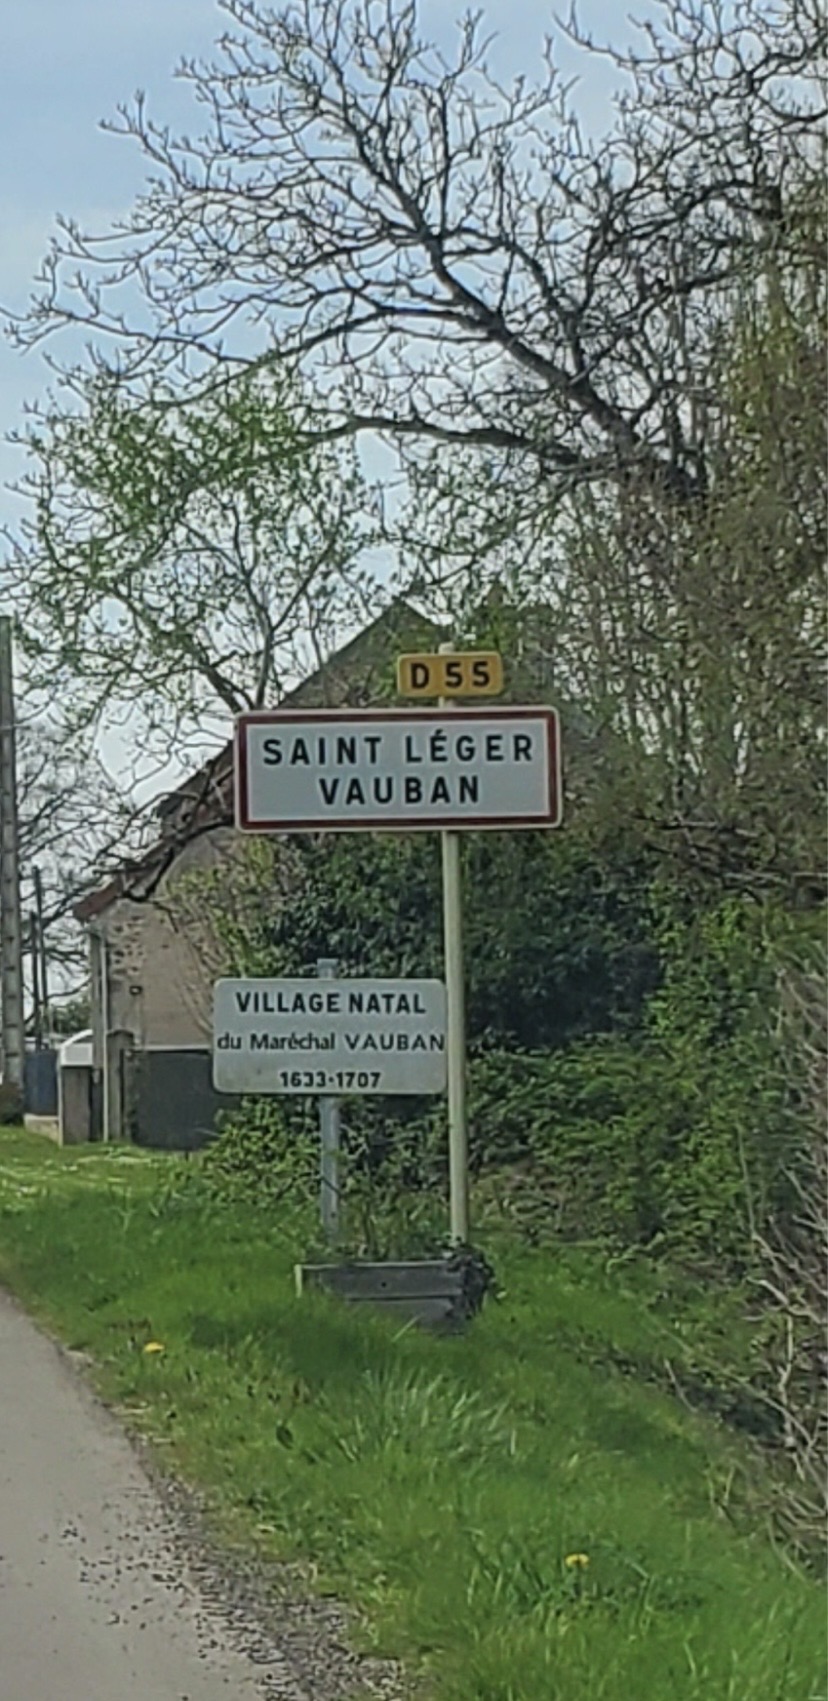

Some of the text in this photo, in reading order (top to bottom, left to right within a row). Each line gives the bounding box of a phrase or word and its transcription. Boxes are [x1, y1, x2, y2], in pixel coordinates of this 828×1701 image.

[411, 661, 490, 689] D 55
[263, 729, 532, 765] SAINT LÉGER
[319, 776, 478, 805] VAUBAN
[236, 992, 426, 1014] VILLAGE NATAL
[217, 1031, 444, 1051] du Maréchal VAUBAN
